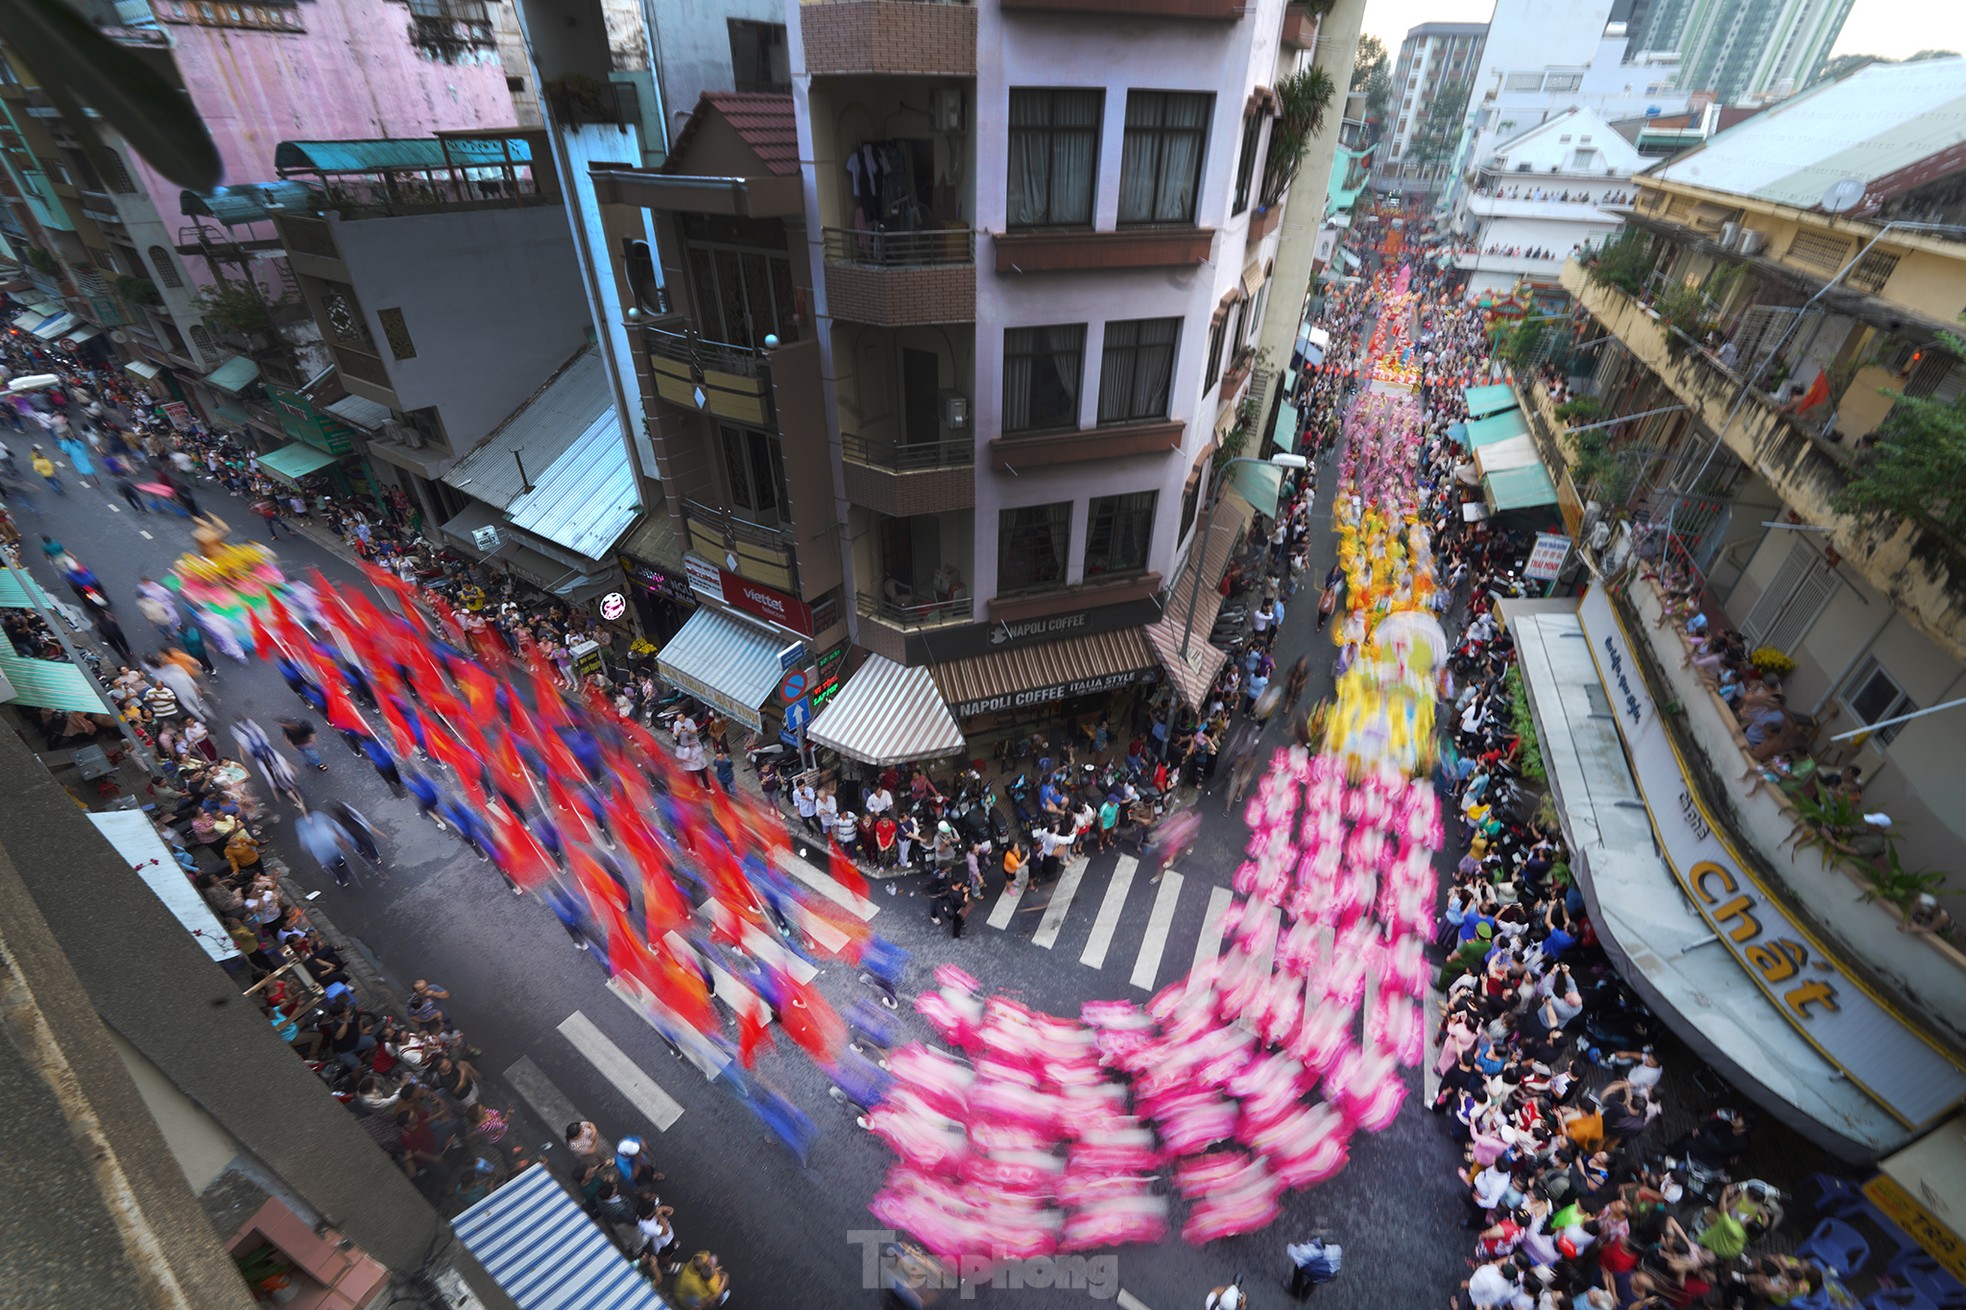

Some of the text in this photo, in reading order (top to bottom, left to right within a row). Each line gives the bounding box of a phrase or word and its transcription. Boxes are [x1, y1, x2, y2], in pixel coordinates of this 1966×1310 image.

[743, 588, 785, 613] Viettel
[762, 606, 787, 620] telecom
[1008, 614, 1086, 638] NAPOLI COFFEE
[813, 683, 839, 706] LAPTOP
[959, 693, 1012, 717] NAPOLI
[1015, 685, 1065, 706] COFFEE
[1070, 678, 1102, 692] ITALIA
[1105, 672, 1136, 685] STYLE
[1684, 807, 1711, 842] phê
[1689, 860, 1841, 1020] Chất
